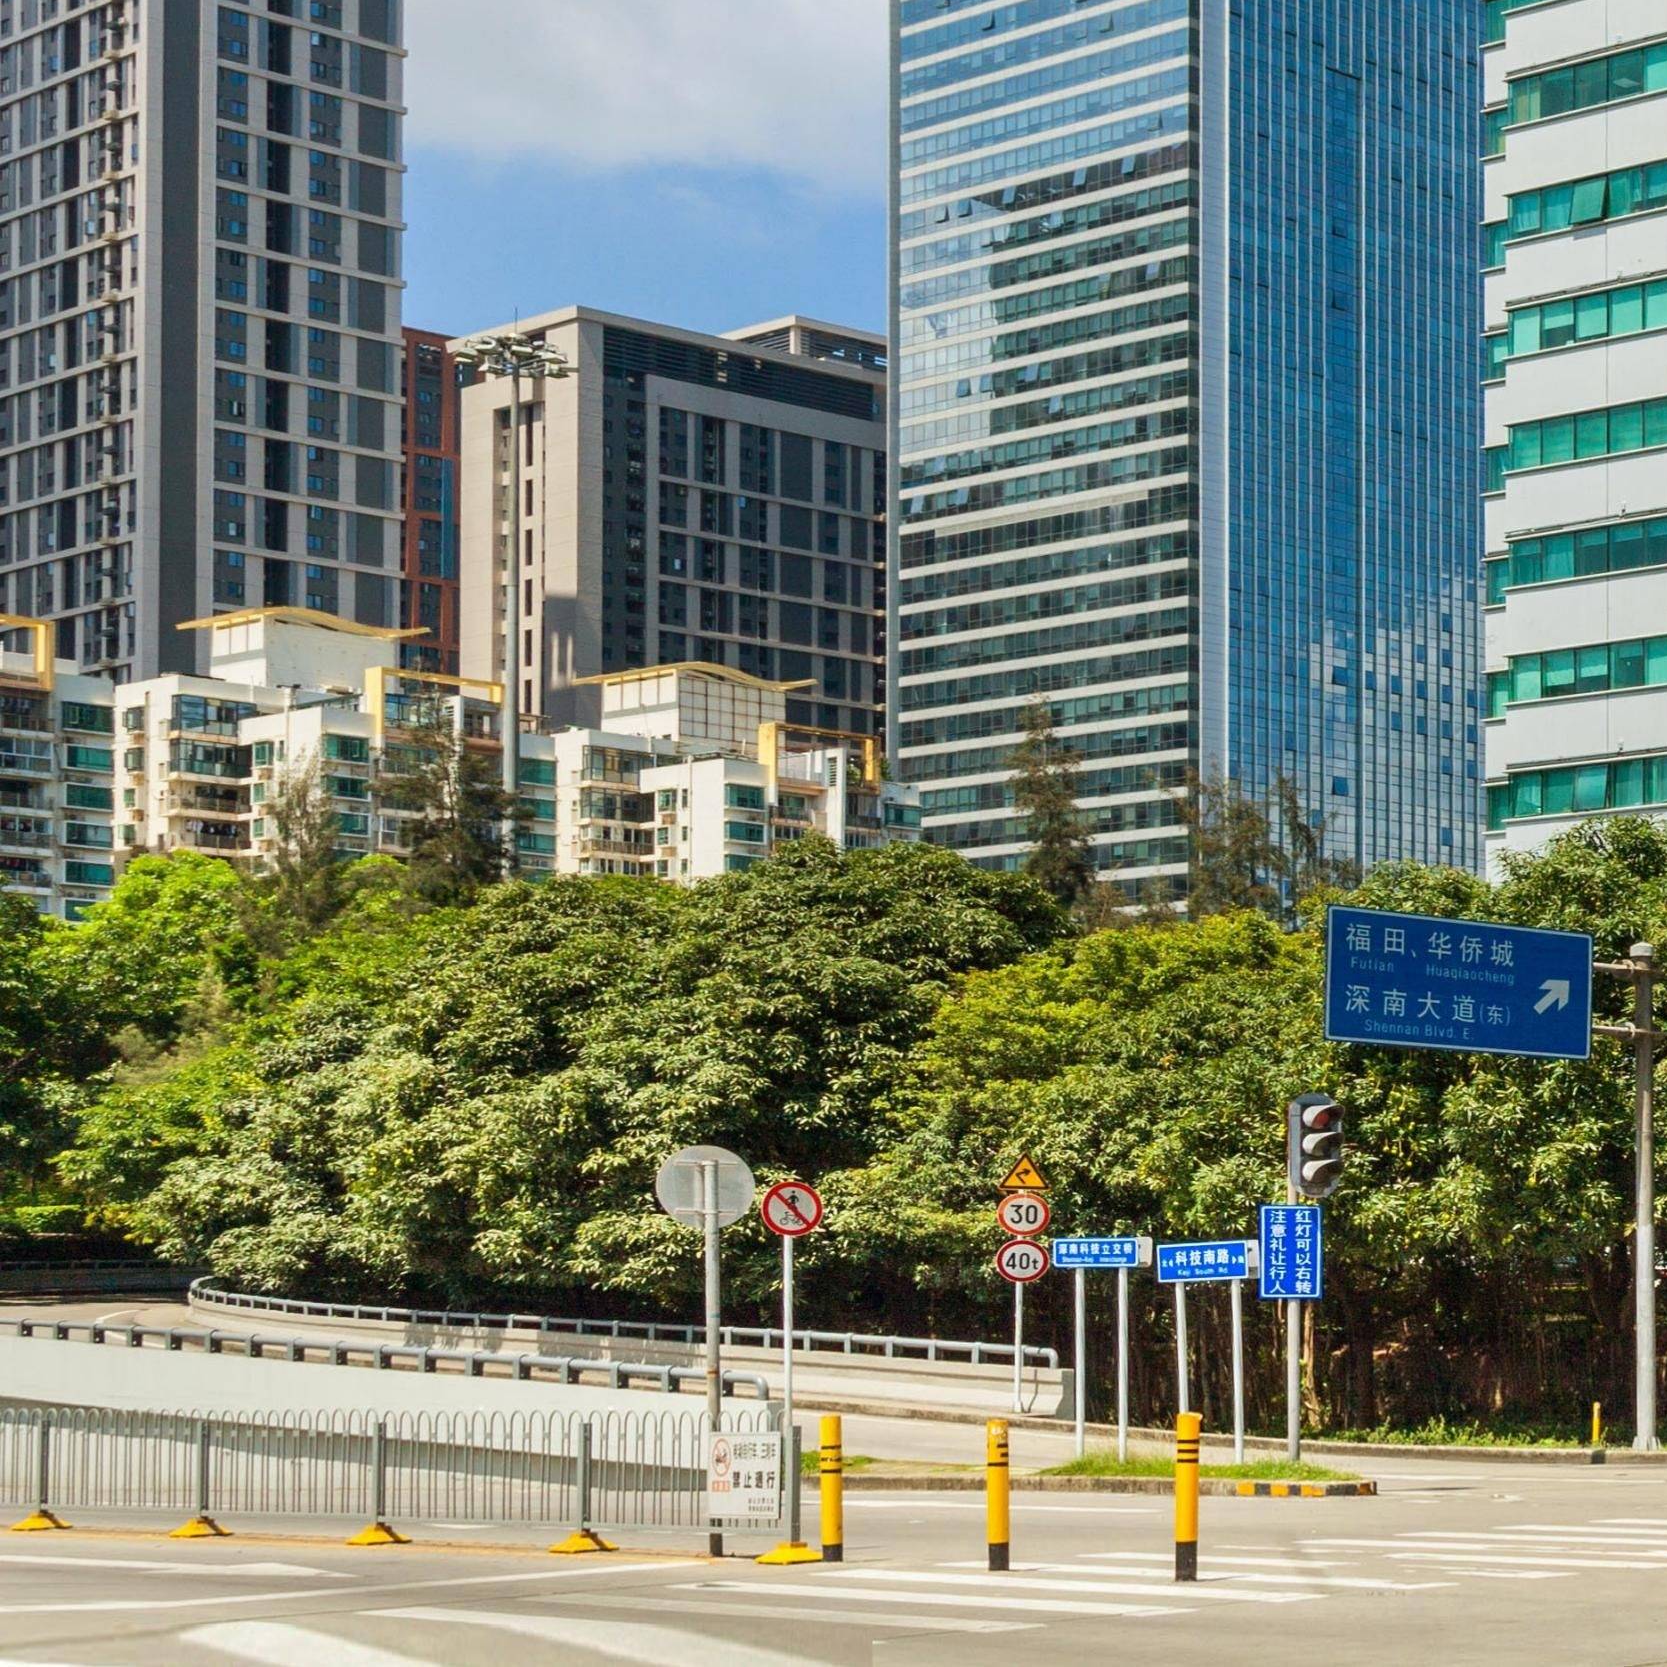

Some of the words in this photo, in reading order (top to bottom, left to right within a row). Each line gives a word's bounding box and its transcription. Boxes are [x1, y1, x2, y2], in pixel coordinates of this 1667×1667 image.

[1350, 957, 1395, 973] Futian
[1425, 964, 1515, 986] Huaqiaocheng
[1364, 1019, 1420, 1037] Shennan
[1010, 1204, 1038, 1225] 30
[1006, 1252, 1039, 1270] 40t
[1175, 1248, 1229, 1266] 科技南路
[1269, 1209, 1288, 1294] 注意礼让行人
[1294, 1209, 1313, 1294] 红灯可以右转
